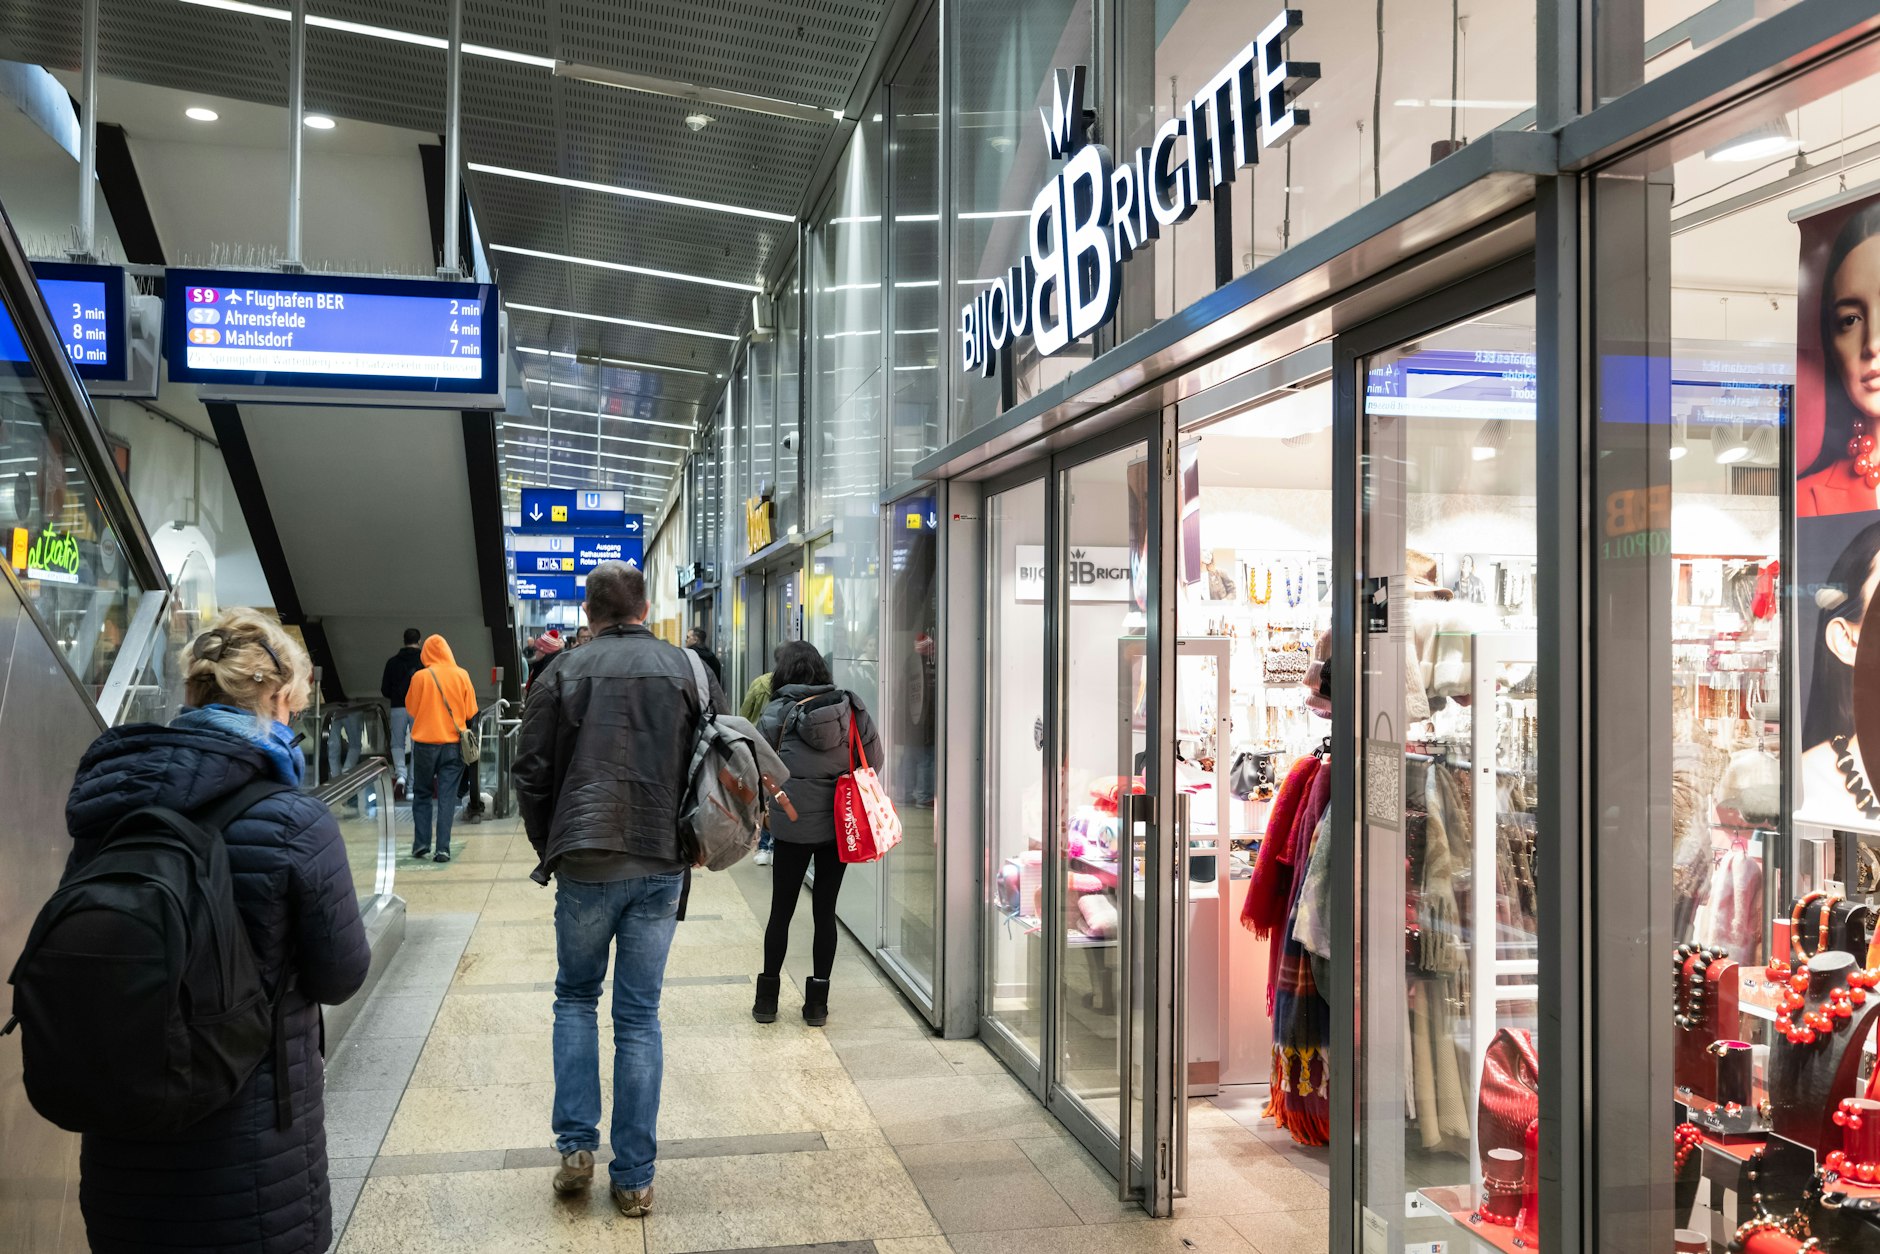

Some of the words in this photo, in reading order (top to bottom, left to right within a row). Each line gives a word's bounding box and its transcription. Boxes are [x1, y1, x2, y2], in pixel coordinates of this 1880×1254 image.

[72, 303, 82, 319] 3
[85, 308, 104, 320] min
[193, 288, 214, 302] S9
[246, 290, 314, 310] Flughafen
[317, 294, 344, 310] BER
[450, 300, 458, 314] 2
[462, 304, 480, 316] min
[194, 310, 214, 322] S7
[225, 310, 306, 328] Ahrensfelde
[450, 320, 458, 334] 4
[462, 324, 480, 335] min
[962, 256, 1033, 378] BIJOU
[73, 324, 82, 339] 8
[86, 328, 106, 340] min
[226, 330, 294, 347] Mahlsdorf
[450, 340, 458, 354] 7
[462, 344, 480, 354] min
[66, 344, 84, 360] 10
[86, 348, 106, 360] min
[596, 544, 622, 552] Ausgang
